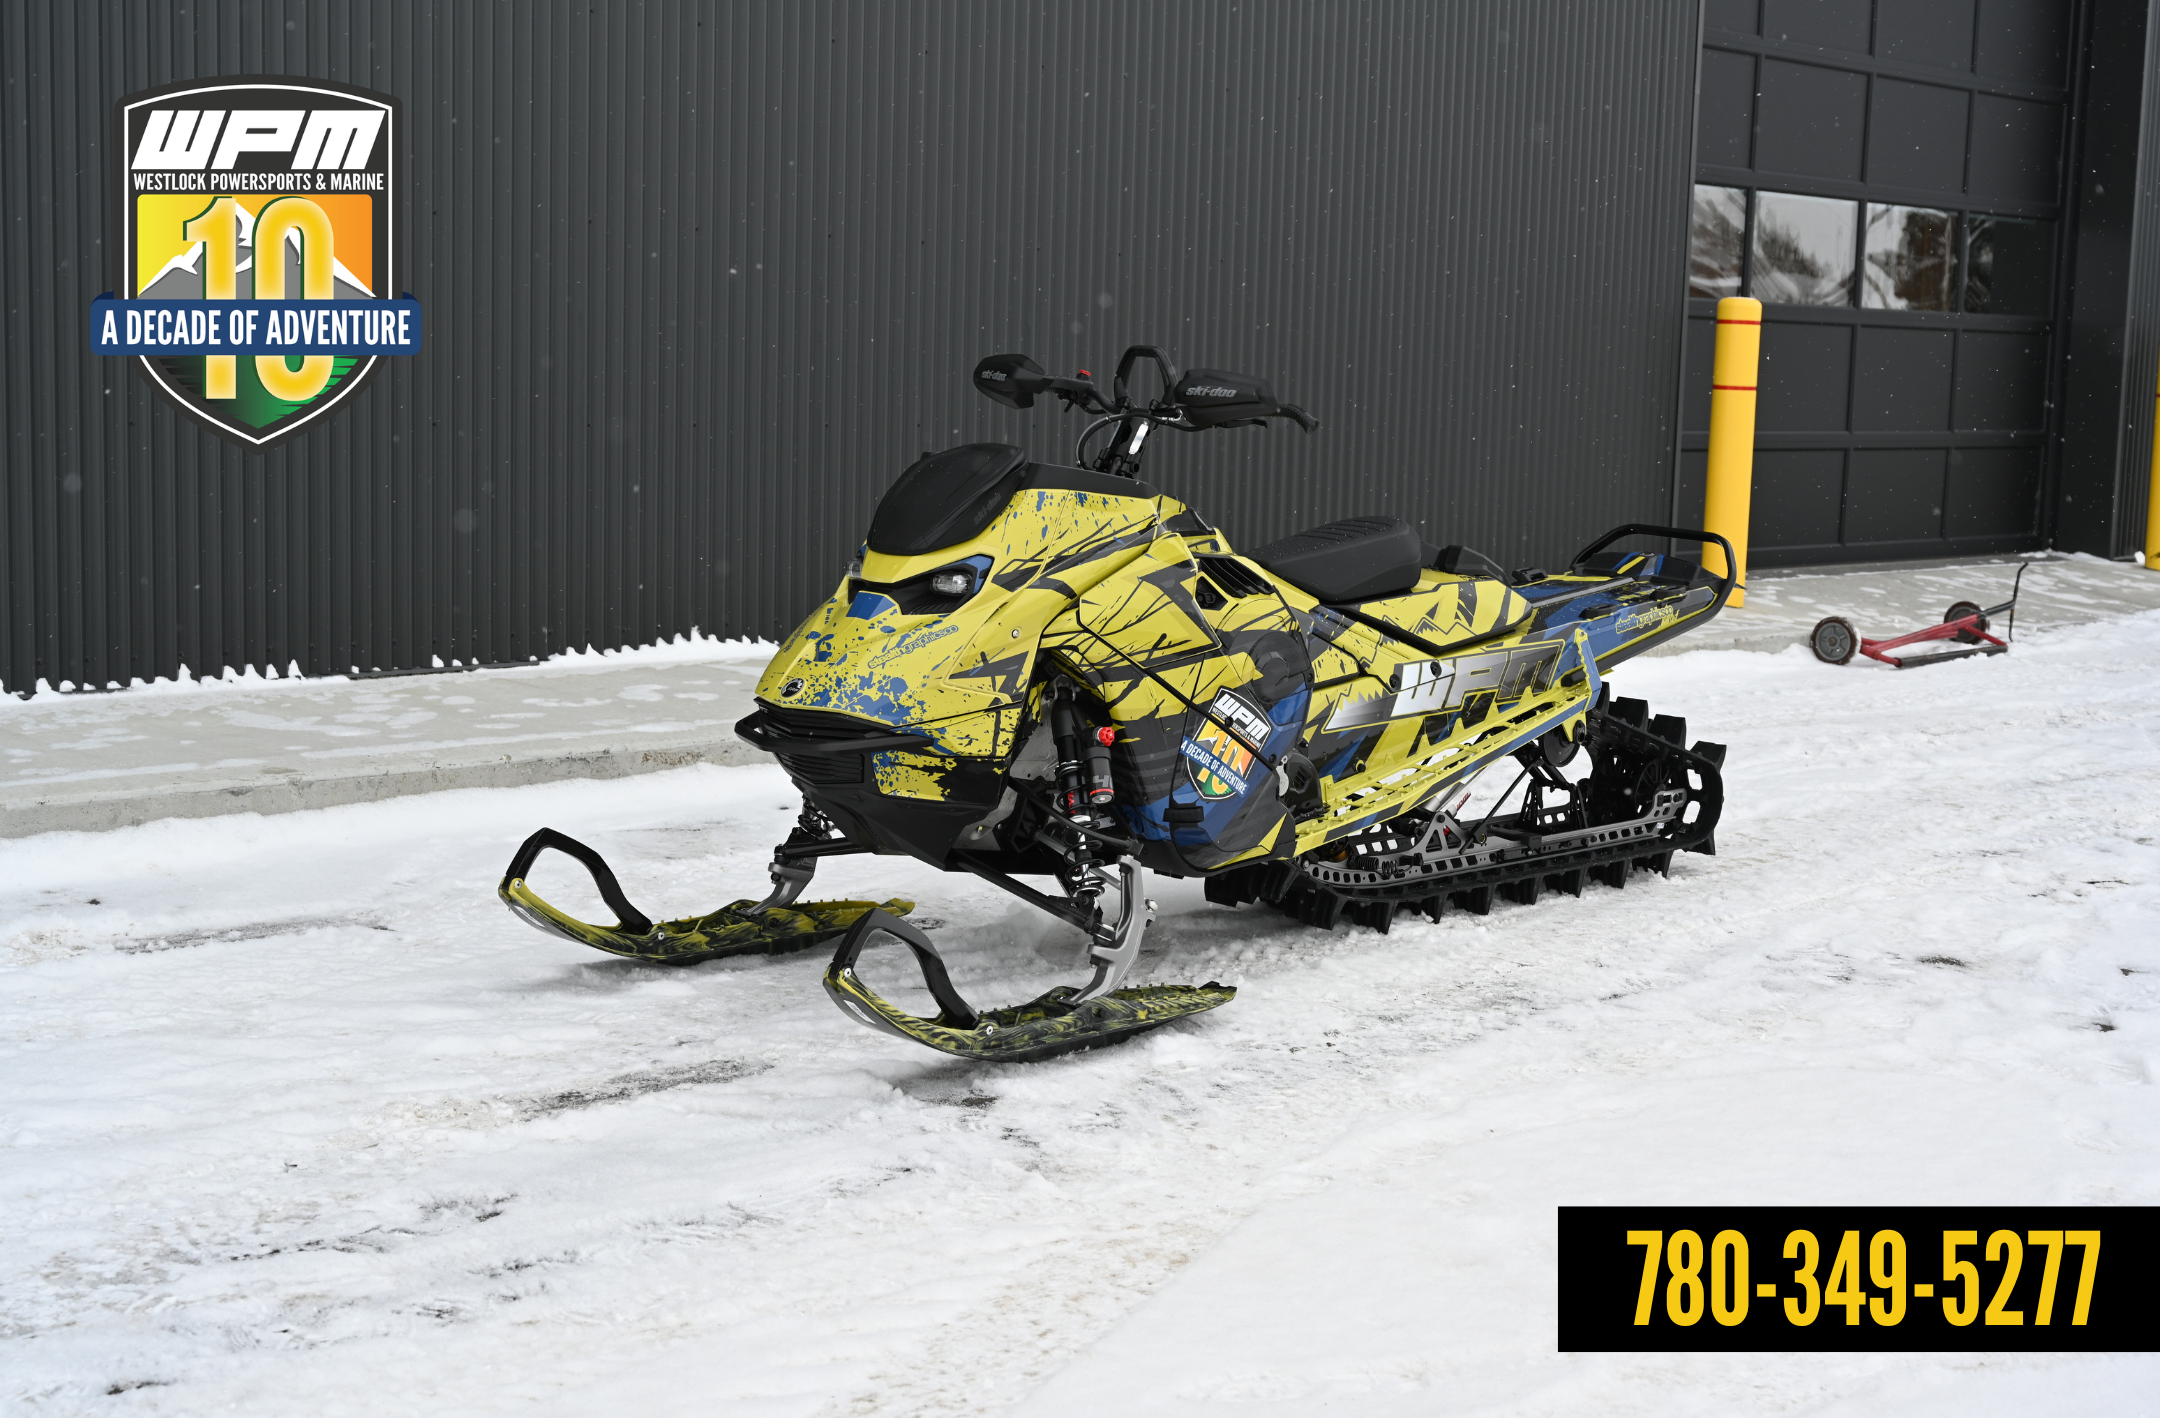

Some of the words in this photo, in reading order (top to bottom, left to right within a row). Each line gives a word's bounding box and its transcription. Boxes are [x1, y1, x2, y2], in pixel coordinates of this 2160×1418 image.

[1185, 386, 1237, 398] ski-doo
[1391, 645, 1562, 718] WPM
[1214, 693, 1270, 741] WPM
[1180, 740, 1188, 751] A
[1185, 743, 1213, 767] DECADE
[1210, 759, 1220, 772] OF
[1217, 763, 1248, 795] ADVENTURE
